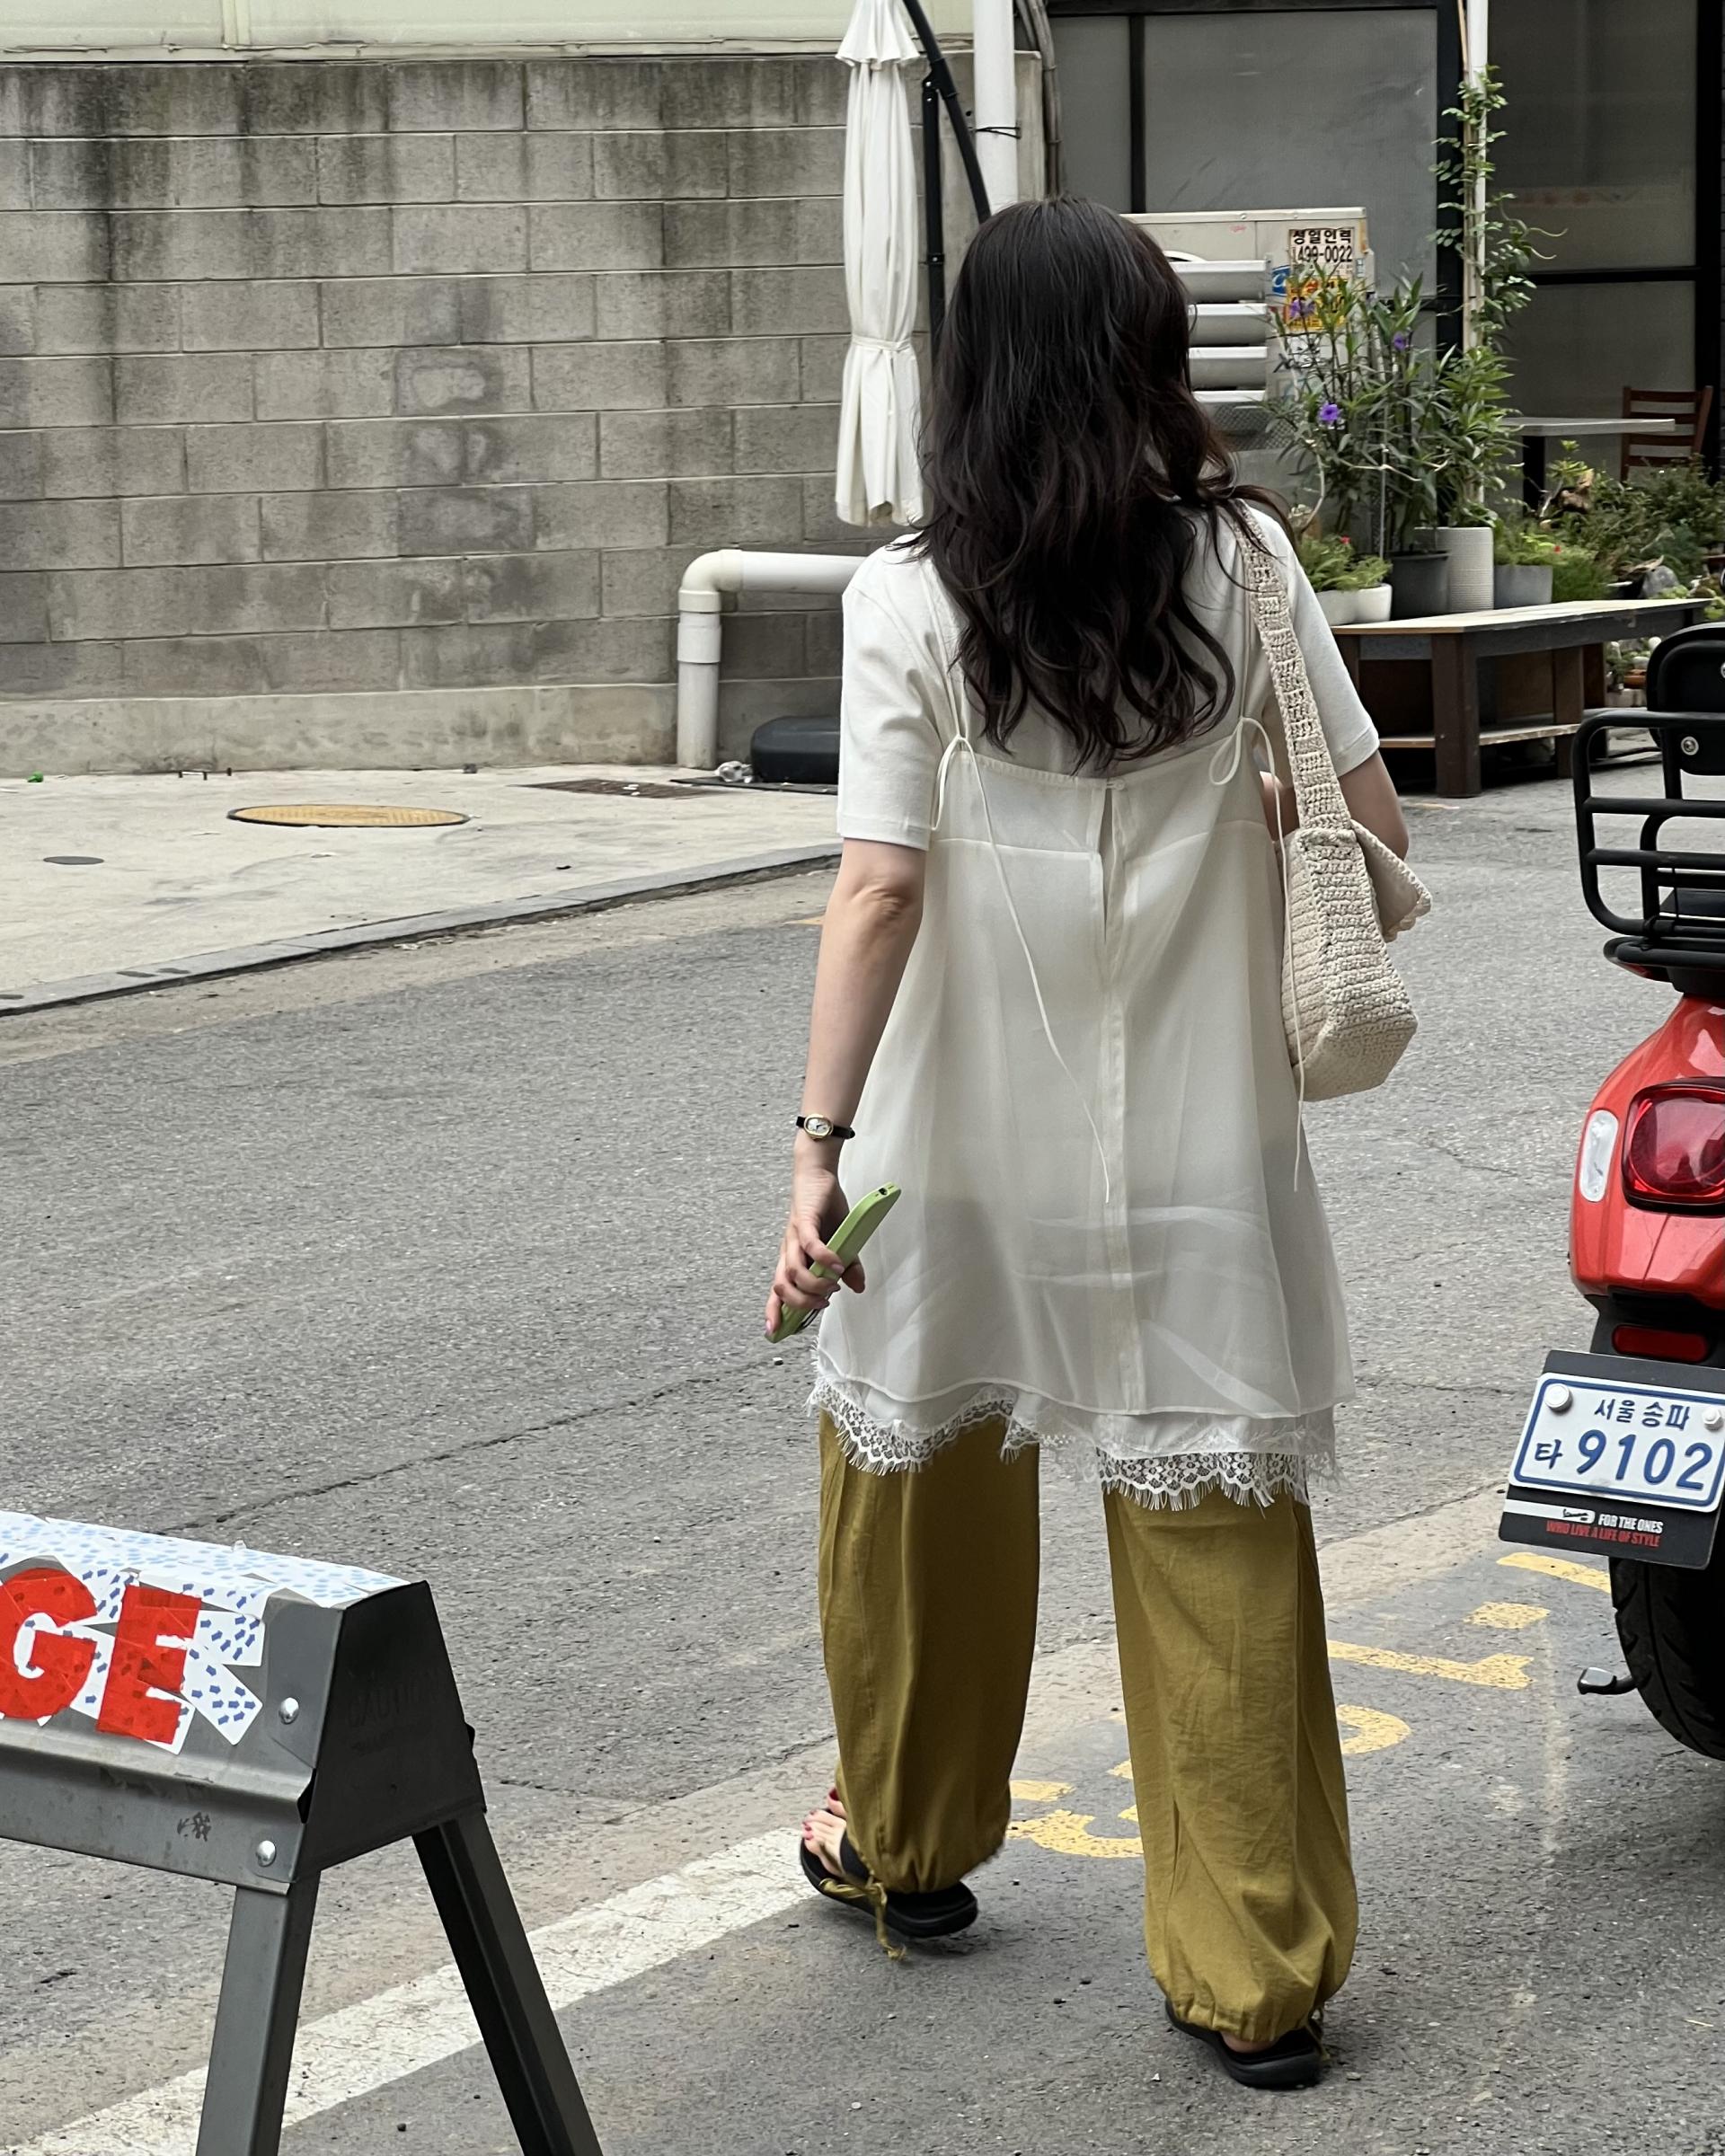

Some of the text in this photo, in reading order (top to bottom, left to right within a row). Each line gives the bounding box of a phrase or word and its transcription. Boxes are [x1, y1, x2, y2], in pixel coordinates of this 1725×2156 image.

[1535, 1429, 1713, 1490] 타 9102
[1546, 1520, 1570, 1534] WHO
[1591, 1526, 1597, 1539] A
[1598, 1528, 1618, 1542] LIFE
[1618, 1530, 1632, 1543] OF
[1631, 1532, 1661, 1548] STYLE
[1597, 1514, 1618, 1527] FOR
[1618, 1515, 1637, 1531] THE
[1637, 1518, 1664, 1534] ONES
